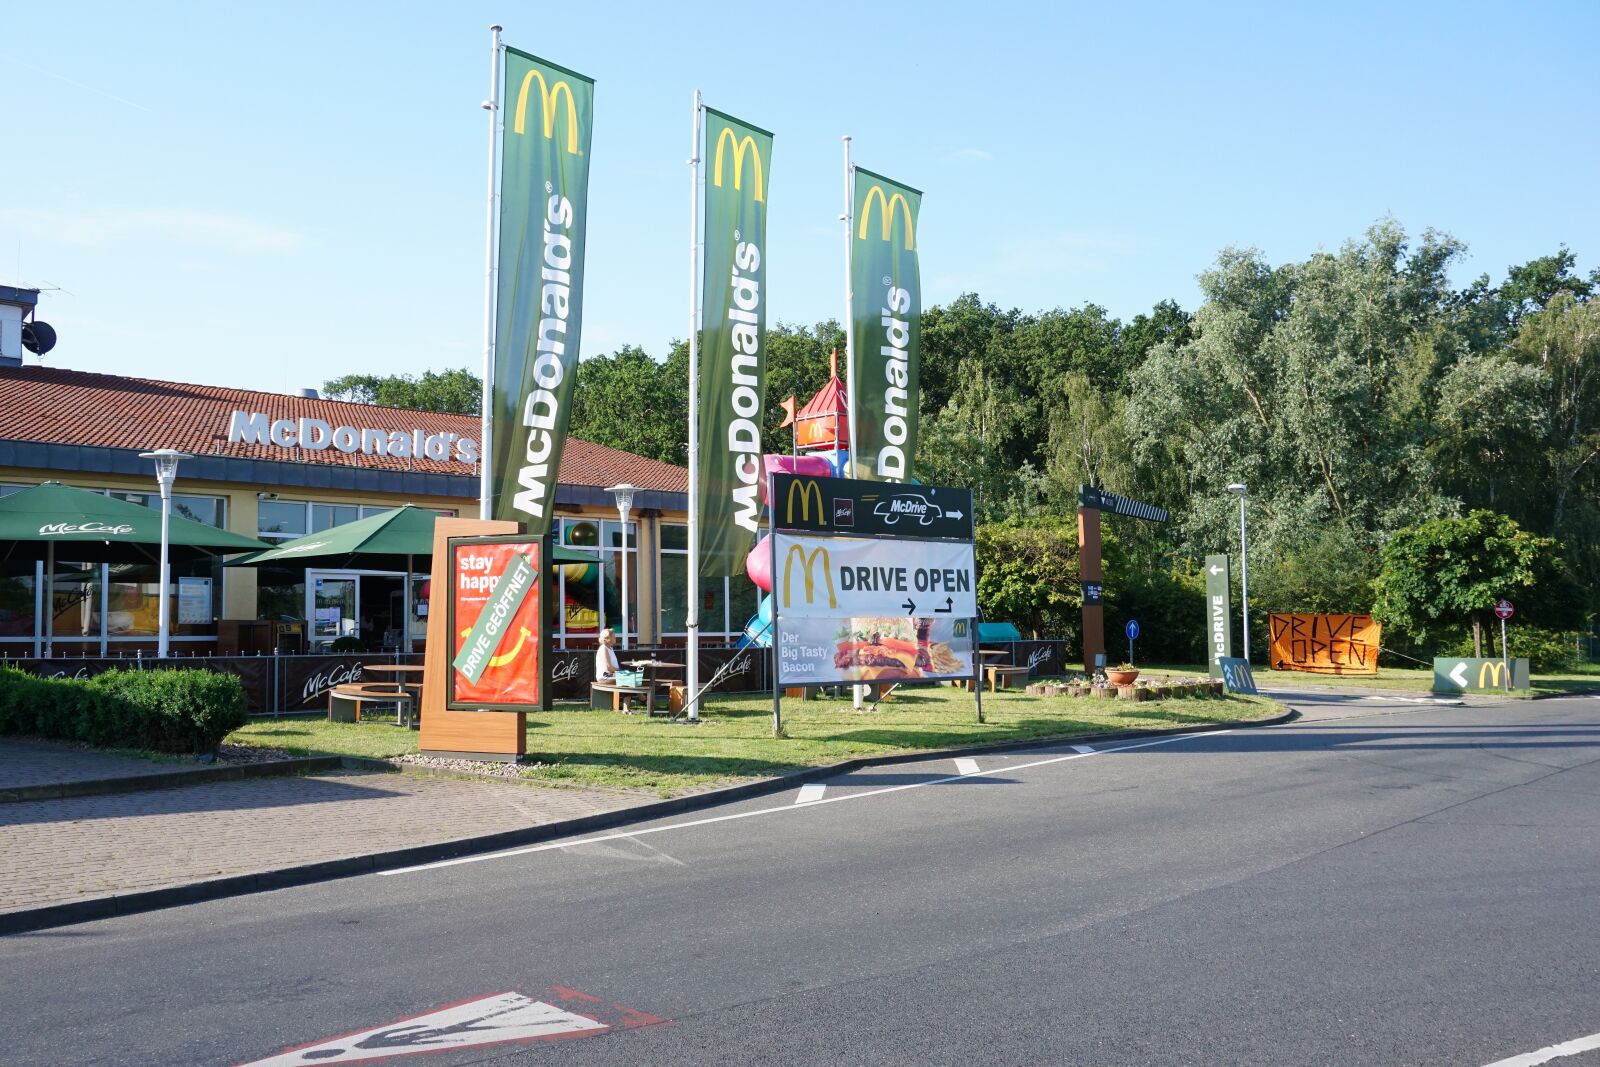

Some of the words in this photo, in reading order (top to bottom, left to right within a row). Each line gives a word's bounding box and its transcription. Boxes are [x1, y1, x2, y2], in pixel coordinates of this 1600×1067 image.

[513, 194, 573, 518] McDonald's
[728, 241, 761, 533] McDonald's
[228, 410, 478, 464] McDonald's
[890, 499, 927, 514] McDrive
[460, 554, 494, 574] stay
[460, 572, 502, 593] happ
[840, 566, 908, 592] DRIVE
[914, 568, 971, 593] OPEN
[462, 634, 491, 678] DRIVE
[485, 562, 530, 636] GEÖFFNET
[1272, 614, 1367, 645] DRIVE
[781, 631, 800, 643] Der
[781, 646, 798, 661] Big
[800, 646, 828, 660] Tasty
[1291, 638, 1367, 666] OPEN
[551, 657, 578, 682] Café
[782, 661, 815, 673] Bacon
